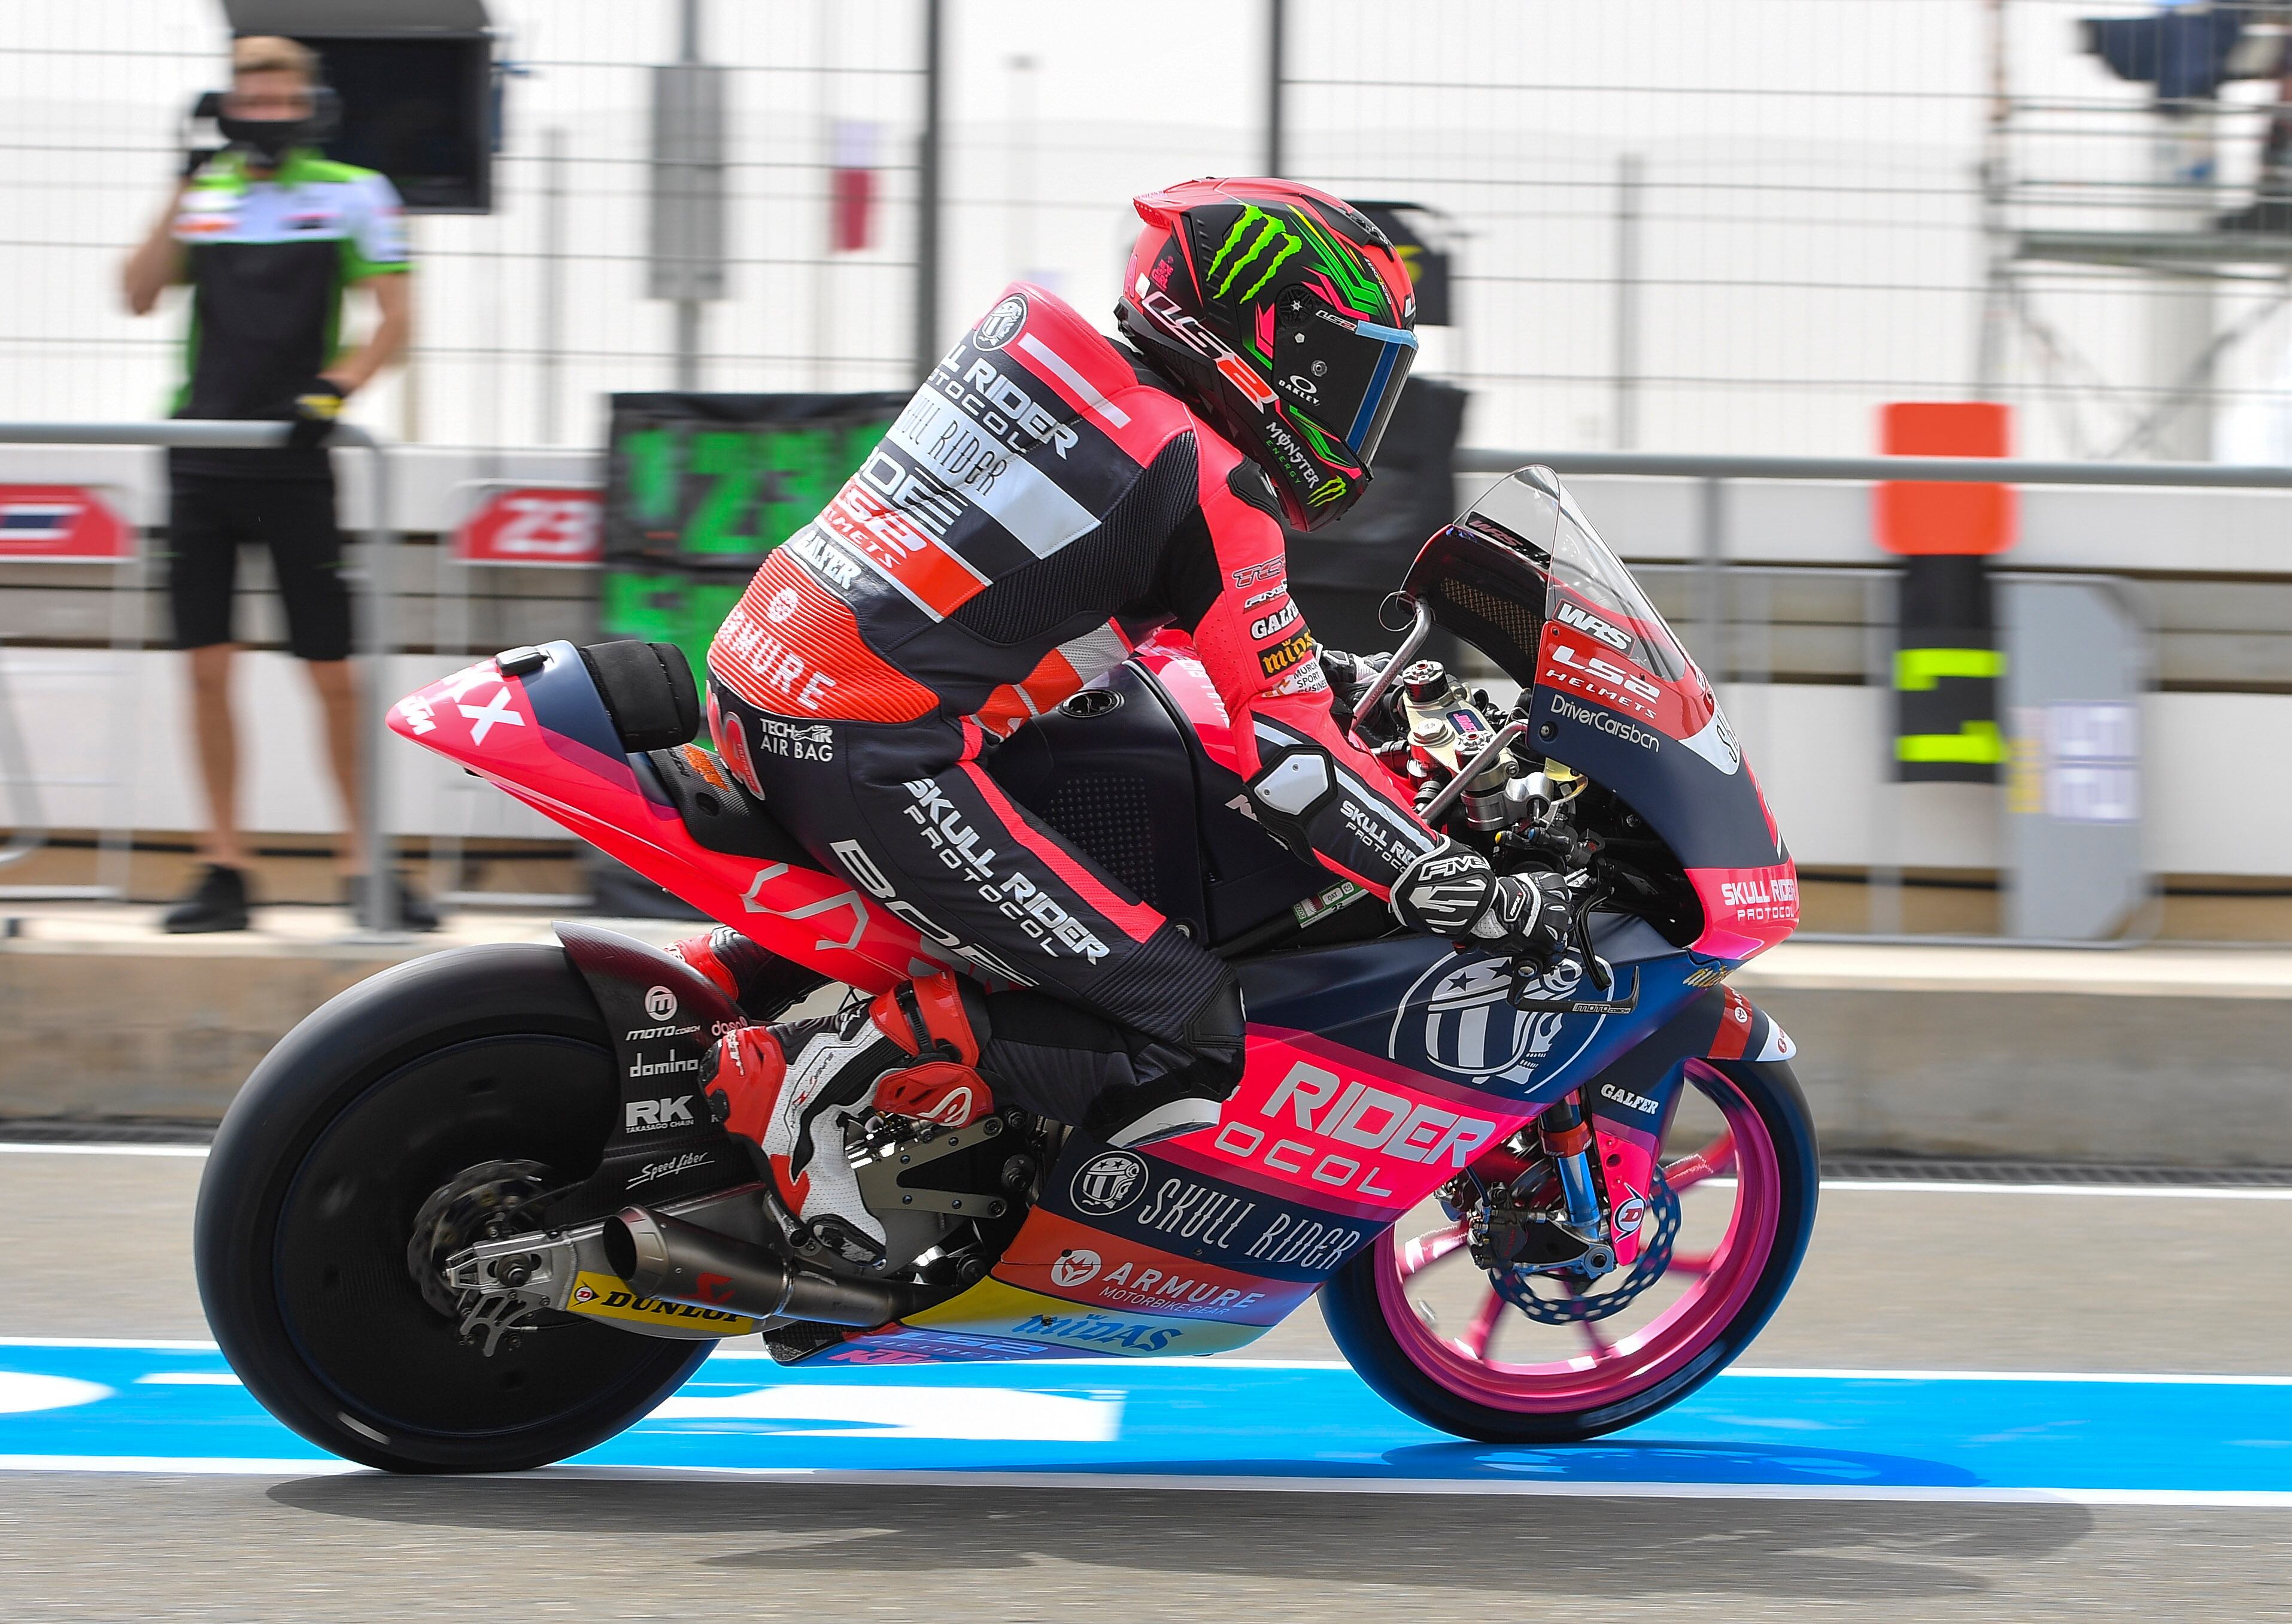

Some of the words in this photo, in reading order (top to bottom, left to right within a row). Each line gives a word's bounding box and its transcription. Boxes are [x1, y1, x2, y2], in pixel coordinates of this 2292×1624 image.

[1316, 310, 1357, 331] LS2
[1142, 291, 1279, 414] LS2
[963, 357, 1079, 460] RIDER
[1278, 380, 1320, 405] OAKLEY
[927, 420, 1007, 497] RIDER
[1265, 421, 1319, 489] MONSTER
[1266, 440, 1301, 484] ENERGY
[1558, 603, 1635, 650] WRS
[1297, 671, 1320, 688] SPORT
[1546, 669, 1657, 719] HELMETS
[1552, 645, 1660, 705] LS2
[1550, 694, 1660, 753] DriverCarsbcn
[760, 736, 789, 757] AIR
[794, 742, 834, 763] BAG
[1340, 800, 1388, 848] SKULL
[901, 779, 997, 878] SKULL
[998, 872, 1111, 966] RIDER
[902, 805, 1059, 958] PROTOCOL
[1722, 881, 1770, 906] SKULL
[1294, 903, 1306, 919] 2022
[1327, 892, 1338, 901] QAT
[1738, 906, 1795, 922] PROTOCOL
[629, 1049, 699, 1077] domino
[626, 1095, 694, 1127] RK
[1260, 1061, 1496, 1168] RIDER
[1601, 1083, 1659, 1115] GALFER
[626, 1122, 668, 1134] TAKASAGO
[670, 1118, 694, 1128] CHAIN
[1138, 1178, 1256, 1249] SKULL
[1244, 1213, 1361, 1270] RIDER
[1098, 1286, 1191, 1312] MOTORBIKE
[1189, 1306, 1231, 1316] GEAR
[1103, 1263, 1266, 1309] ARMURE
[862, 1331, 1049, 1356] LS2
